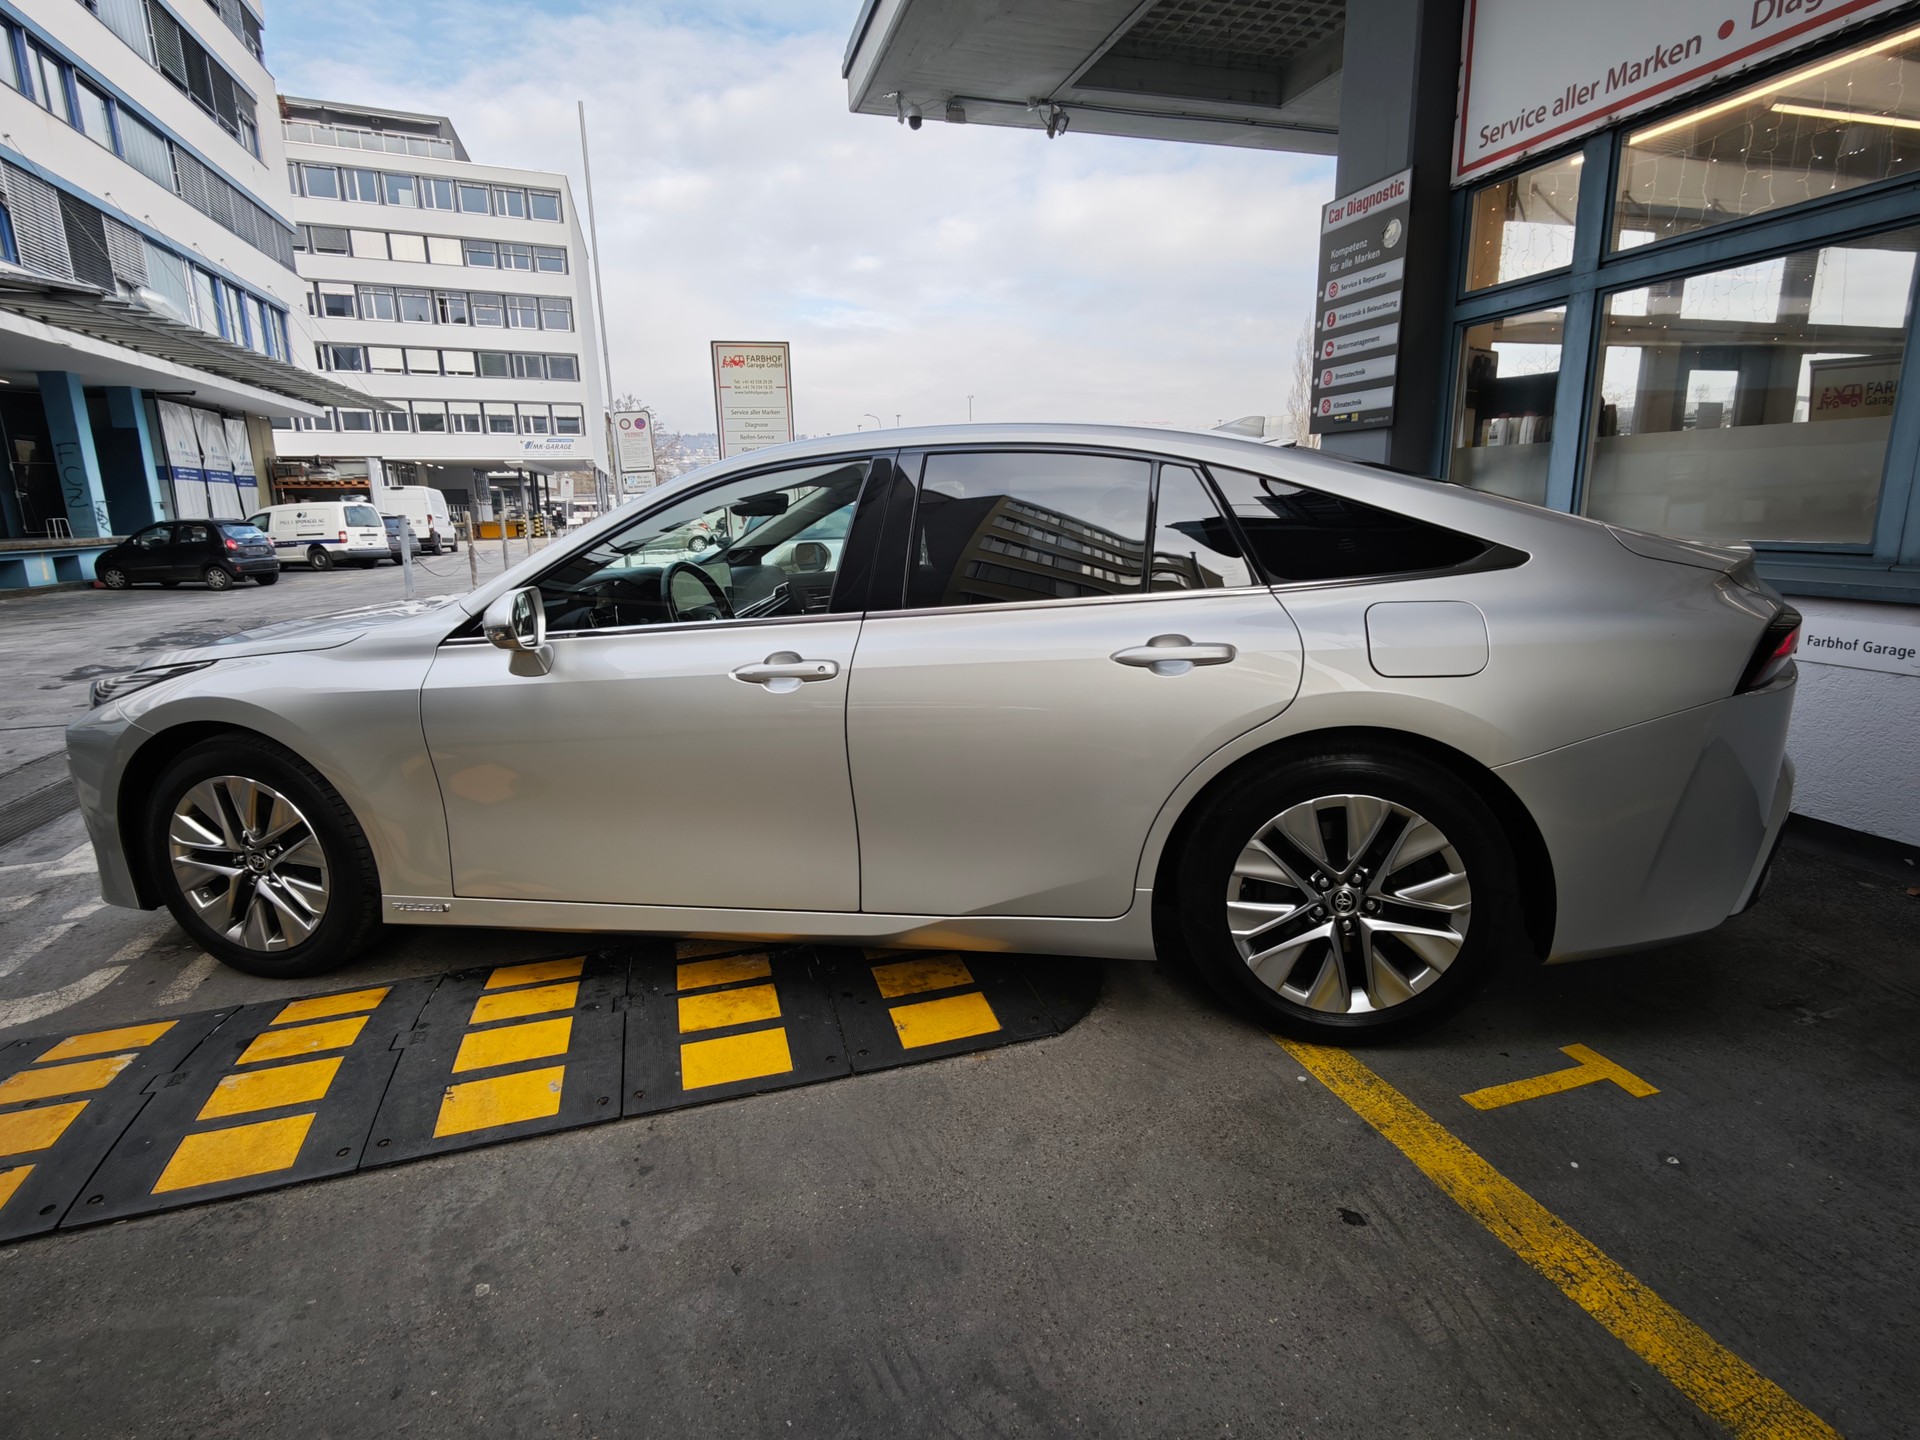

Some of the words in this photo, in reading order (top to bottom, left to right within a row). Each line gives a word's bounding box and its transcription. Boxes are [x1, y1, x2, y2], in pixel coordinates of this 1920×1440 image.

[1479, 106, 1546, 149] Service
[1552, 83, 1599, 117] aller
[1605, 35, 1702, 94] Marken
[1328, 206, 1345, 224] Car
[1346, 179, 1405, 217] Diagnostic
[1330, 240, 1368, 260] Kompetenz
[1329, 263, 1339, 273] für
[1341, 259, 1352, 270] alle
[1354, 249, 1381, 265] Marken
[1340, 281, 1358, 291] Service
[1362, 271, 1387, 284] Reparatur
[1338, 309, 1361, 321] Elektronik
[1366, 300, 1398, 314] Beleuchtung
[1336, 336, 1380, 350] Motormanagement
[746, 355, 782, 363] FARBHOF
[1335, 368, 1366, 380] Bremstechnik
[1866, 380, 1899, 395] FAR
[1333, 399, 1362, 409] Klimatechnik
[744, 421, 769, 429] Diagnose
[1807, 634, 1859, 651] Farbhof
[1863, 641, 1916, 660] Garage
